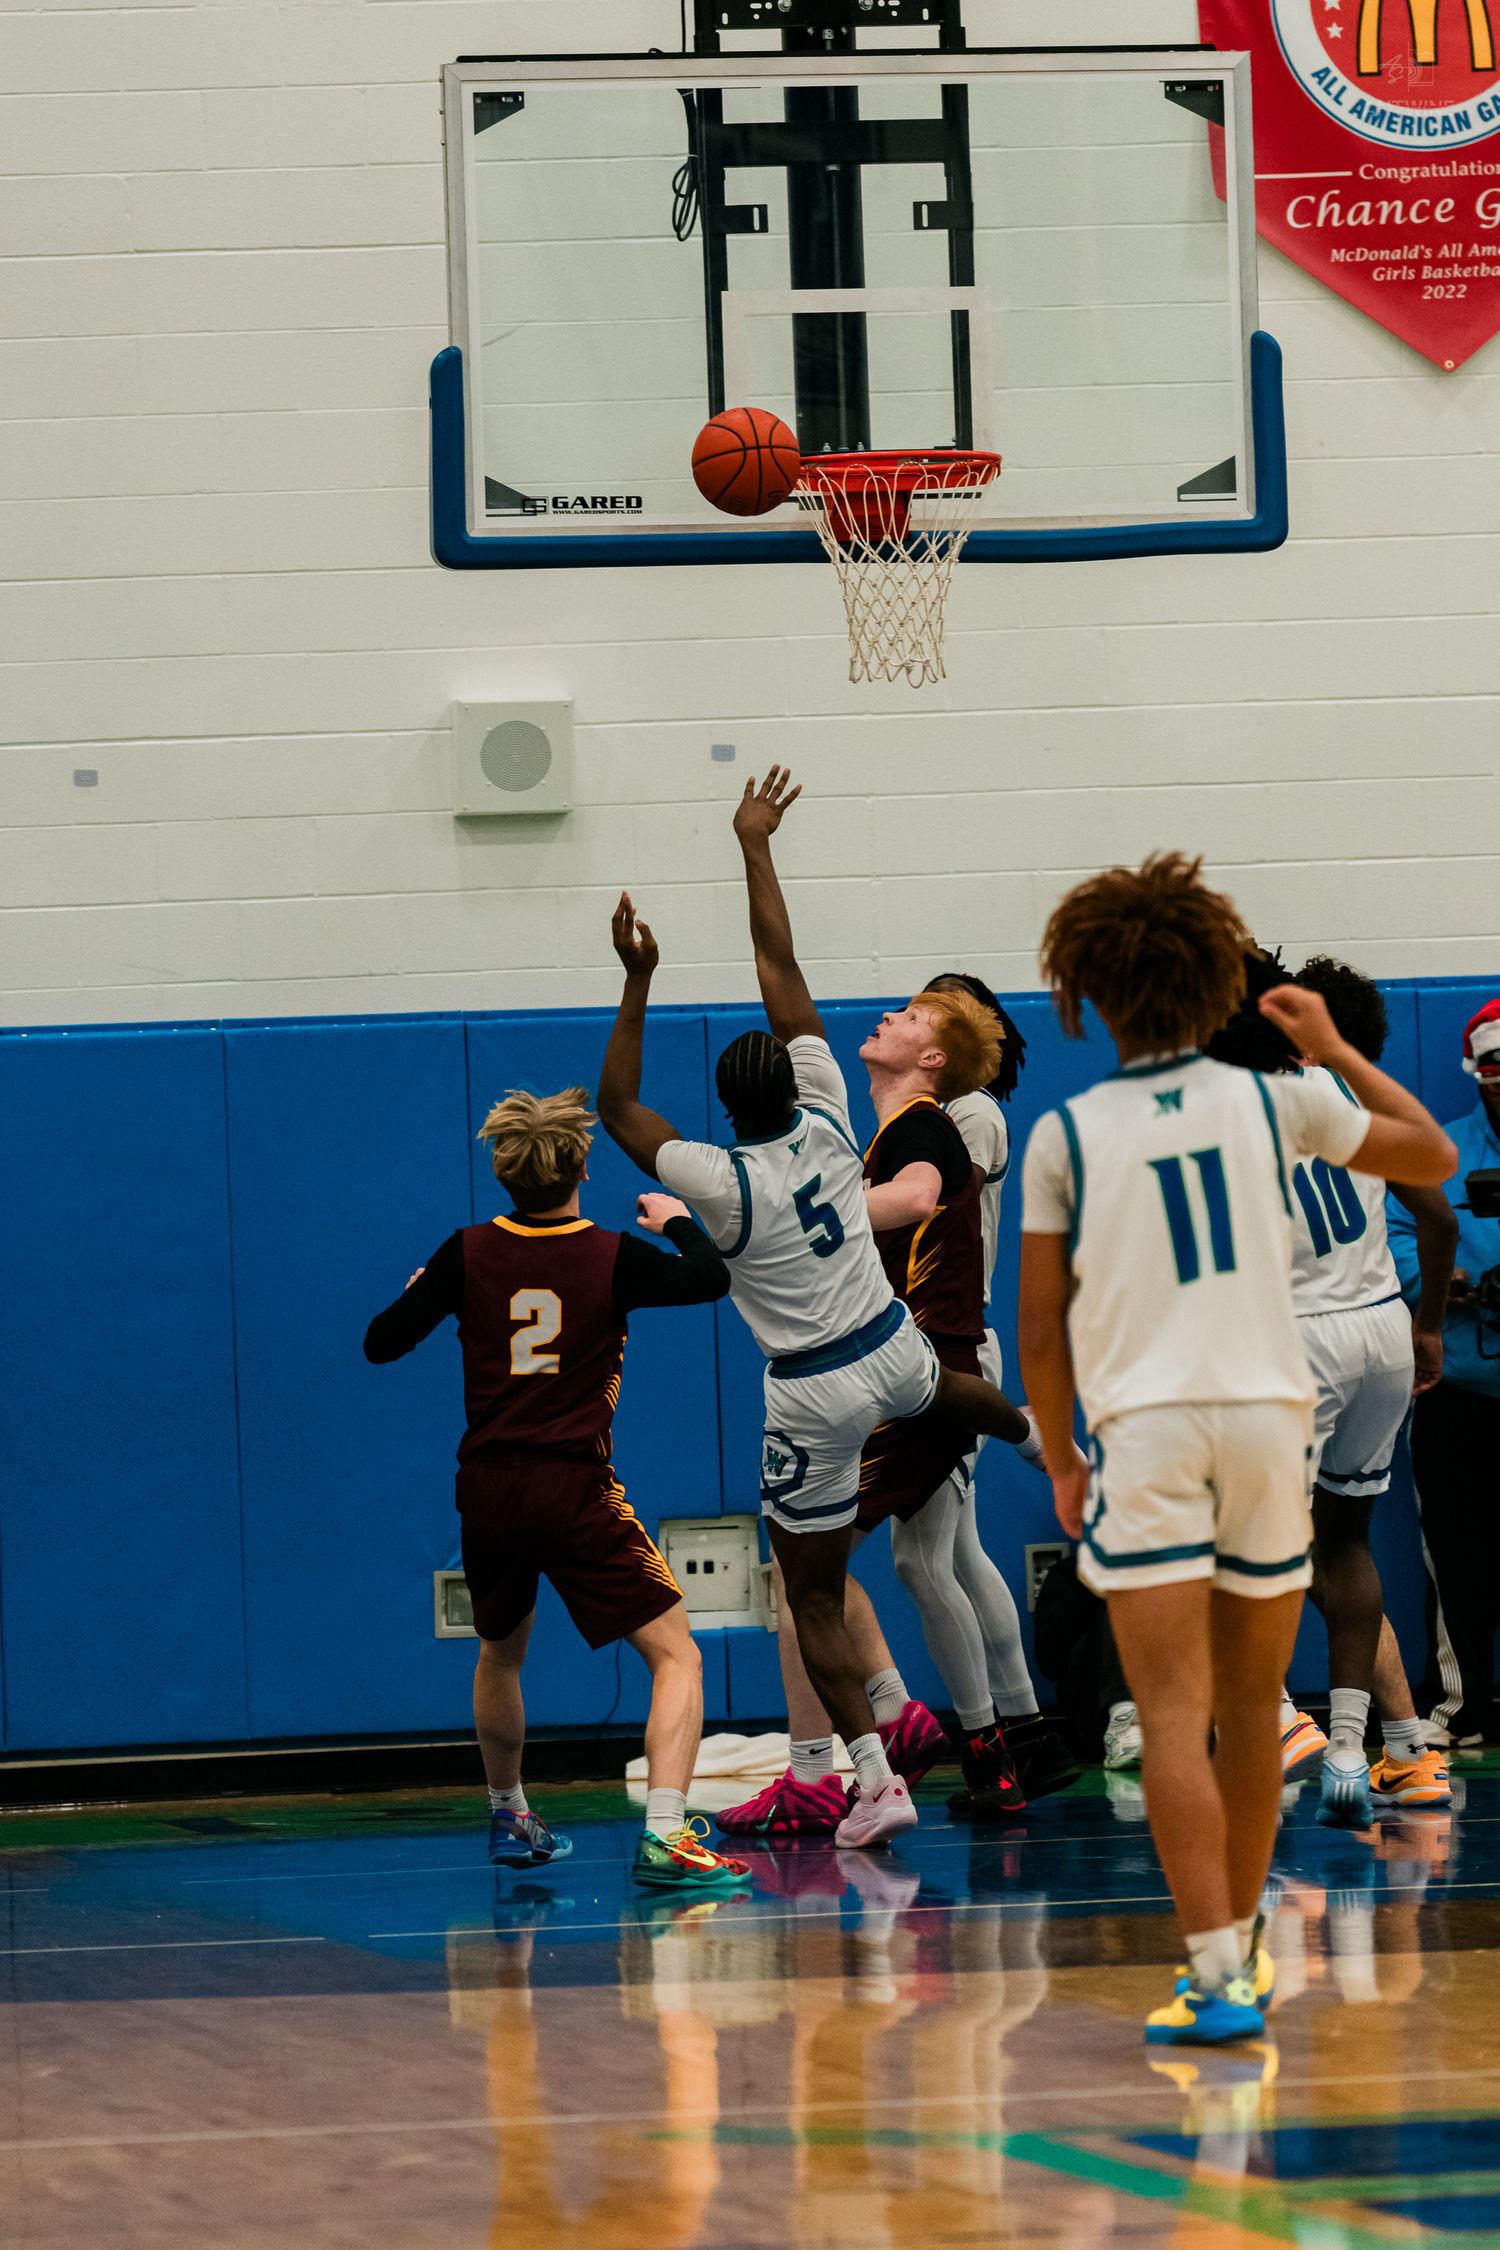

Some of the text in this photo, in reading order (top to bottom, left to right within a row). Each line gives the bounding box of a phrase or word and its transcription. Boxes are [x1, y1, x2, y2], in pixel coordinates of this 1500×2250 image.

[1311, 66, 1348, 106] ALL
[1348, 98, 1472, 137] AMERICAN
[1286, 189, 1455, 229] Chance
[1330, 244, 1433, 262] McDonald's
[1437, 243, 1463, 258] All
[1372, 265, 1416, 281] Girls
[1422, 284, 1468, 300] 2022
[552, 496, 643, 509] GARED
[793, 1172, 846, 1259] 5
[1147, 1146, 1238, 1286] 11
[1292, 1155, 1368, 1259] 10
[510, 1288, 562, 1376] 2
